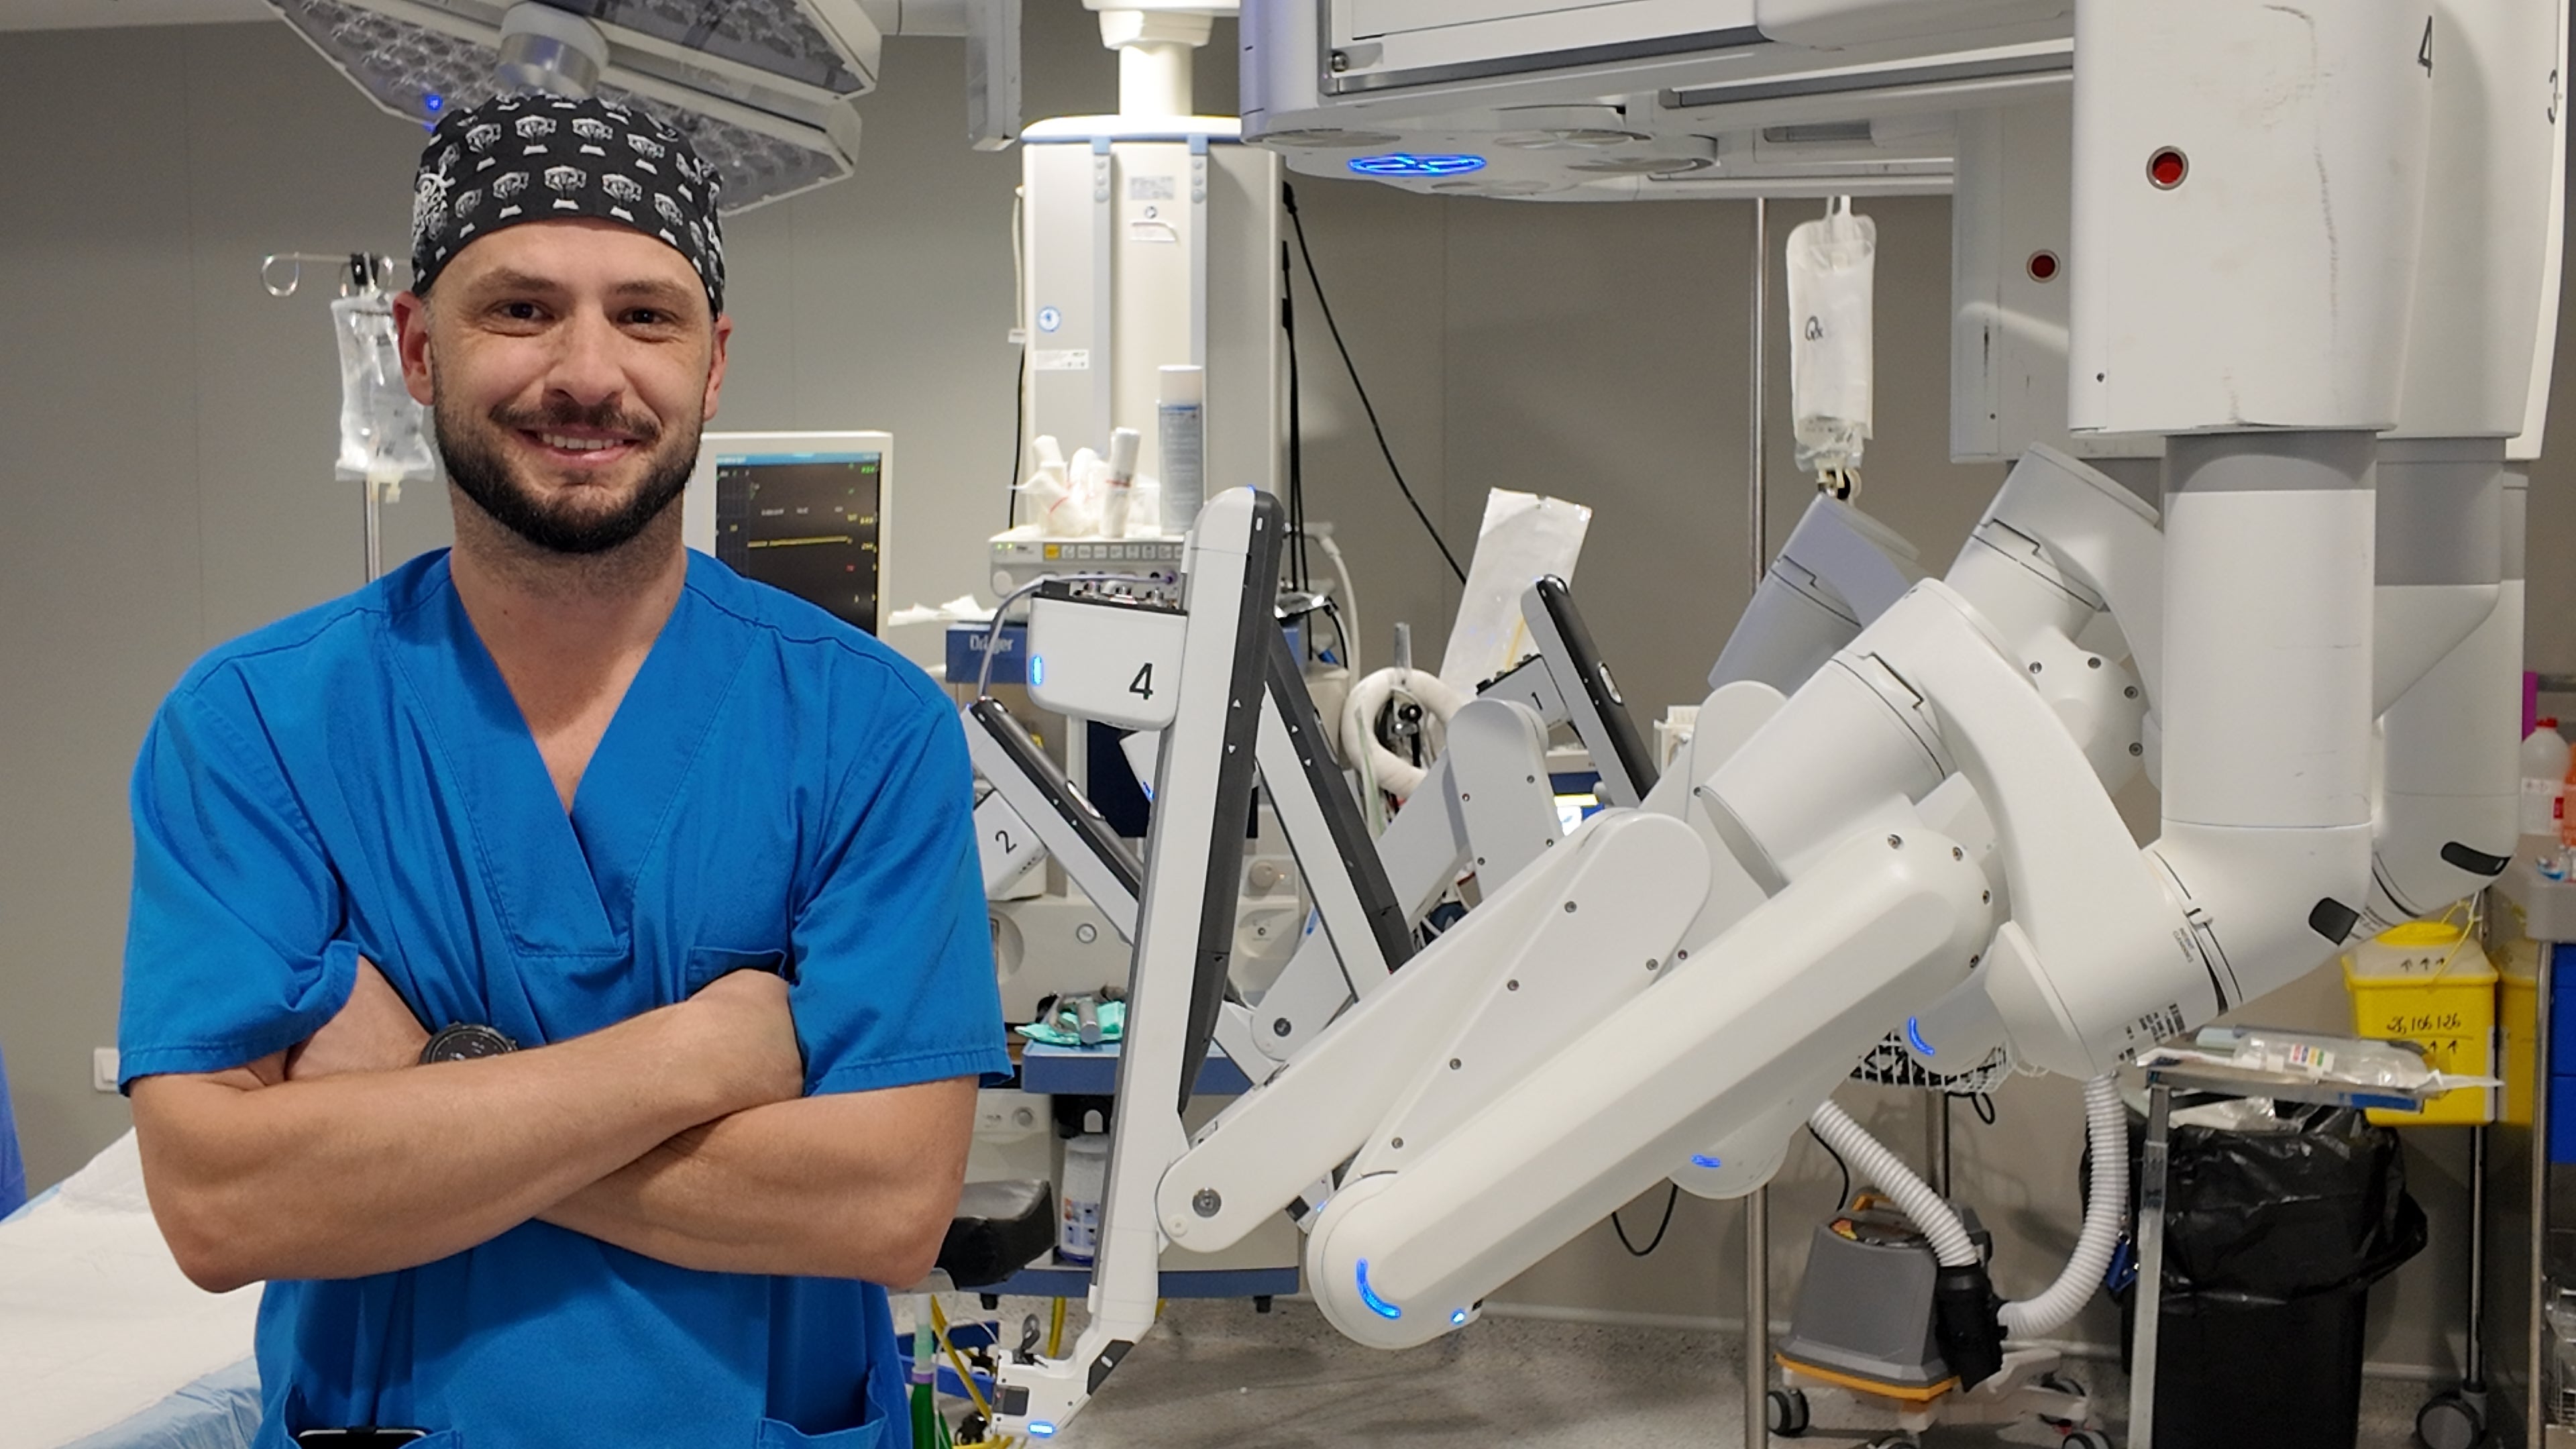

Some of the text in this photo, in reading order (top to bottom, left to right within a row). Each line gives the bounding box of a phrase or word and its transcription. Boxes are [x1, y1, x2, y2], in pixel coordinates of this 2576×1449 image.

[2417, 15, 2432, 78] 4
[2547, 68, 2558, 125] 3
[1128, 662, 1153, 700] 4
[1531, 691, 1543, 711] 1
[995, 830, 1018, 855] 2
